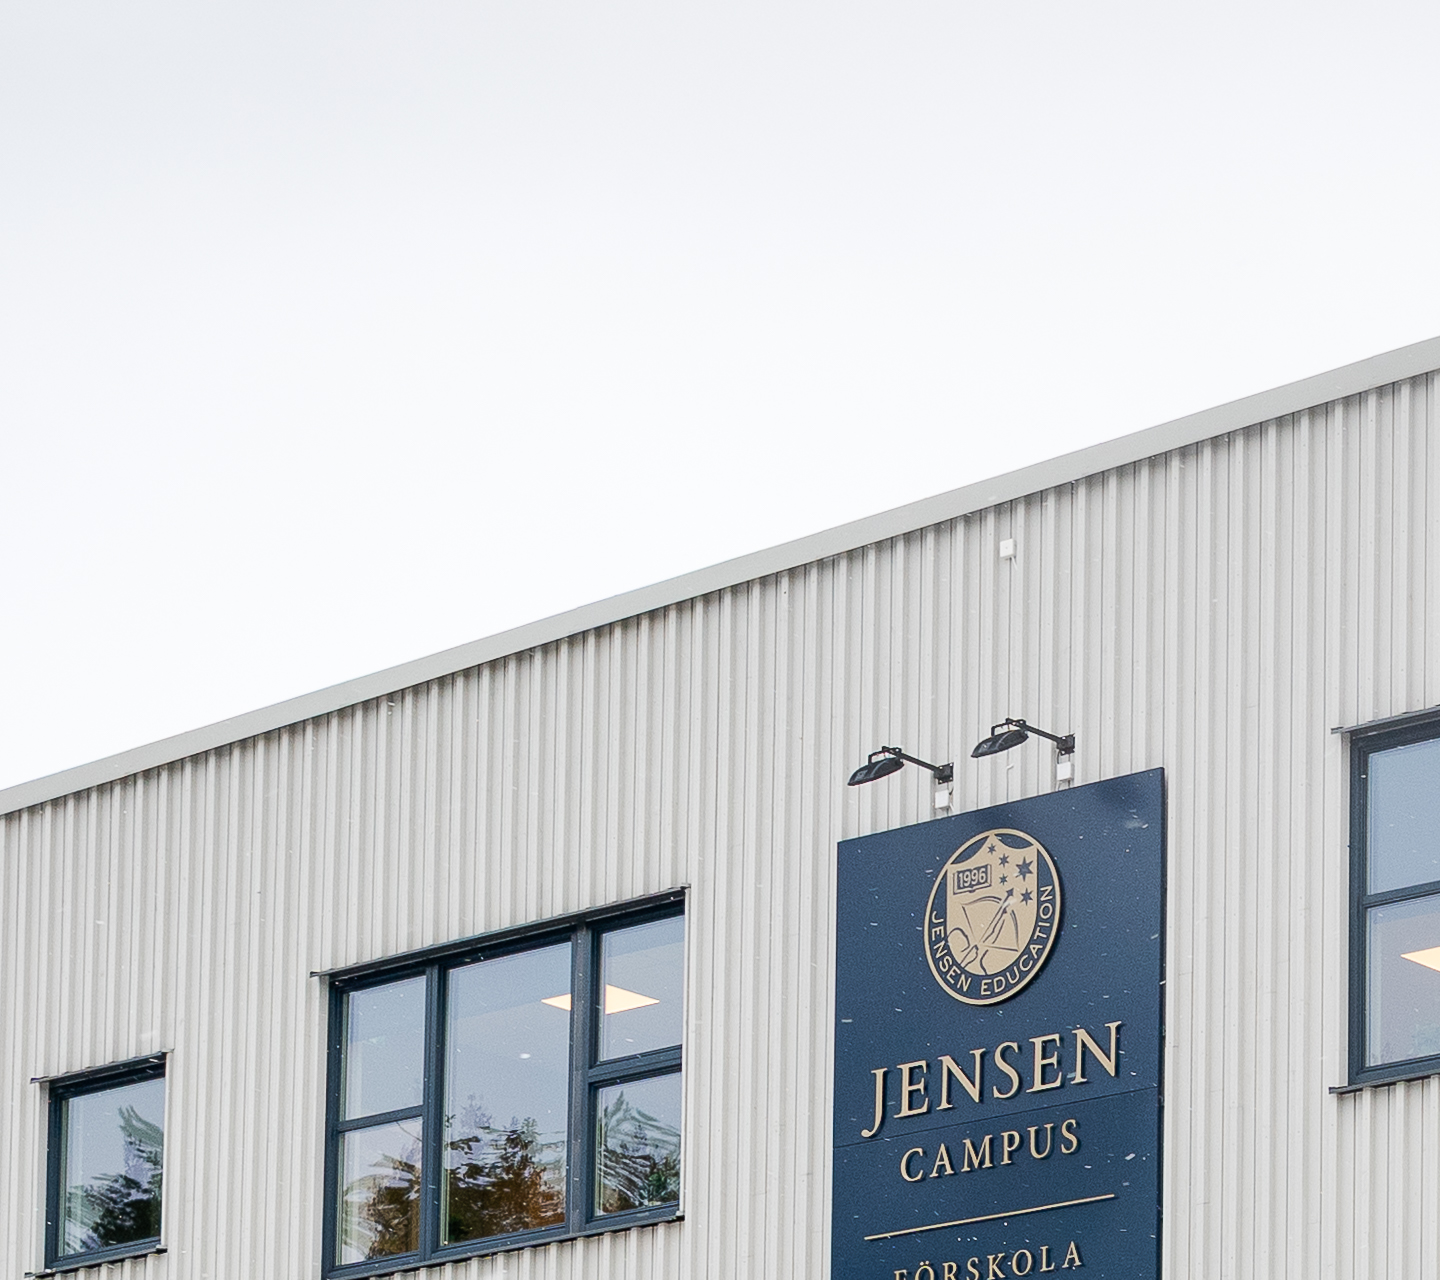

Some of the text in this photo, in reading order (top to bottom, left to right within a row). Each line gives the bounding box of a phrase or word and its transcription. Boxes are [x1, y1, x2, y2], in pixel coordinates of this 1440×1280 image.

[958, 868, 986, 888] 1996
[931, 886, 1053, 995] JENSEN EDUCATION
[861, 1019, 1125, 1138] JENSEN
[900, 1119, 1081, 1184] CAMPUS
